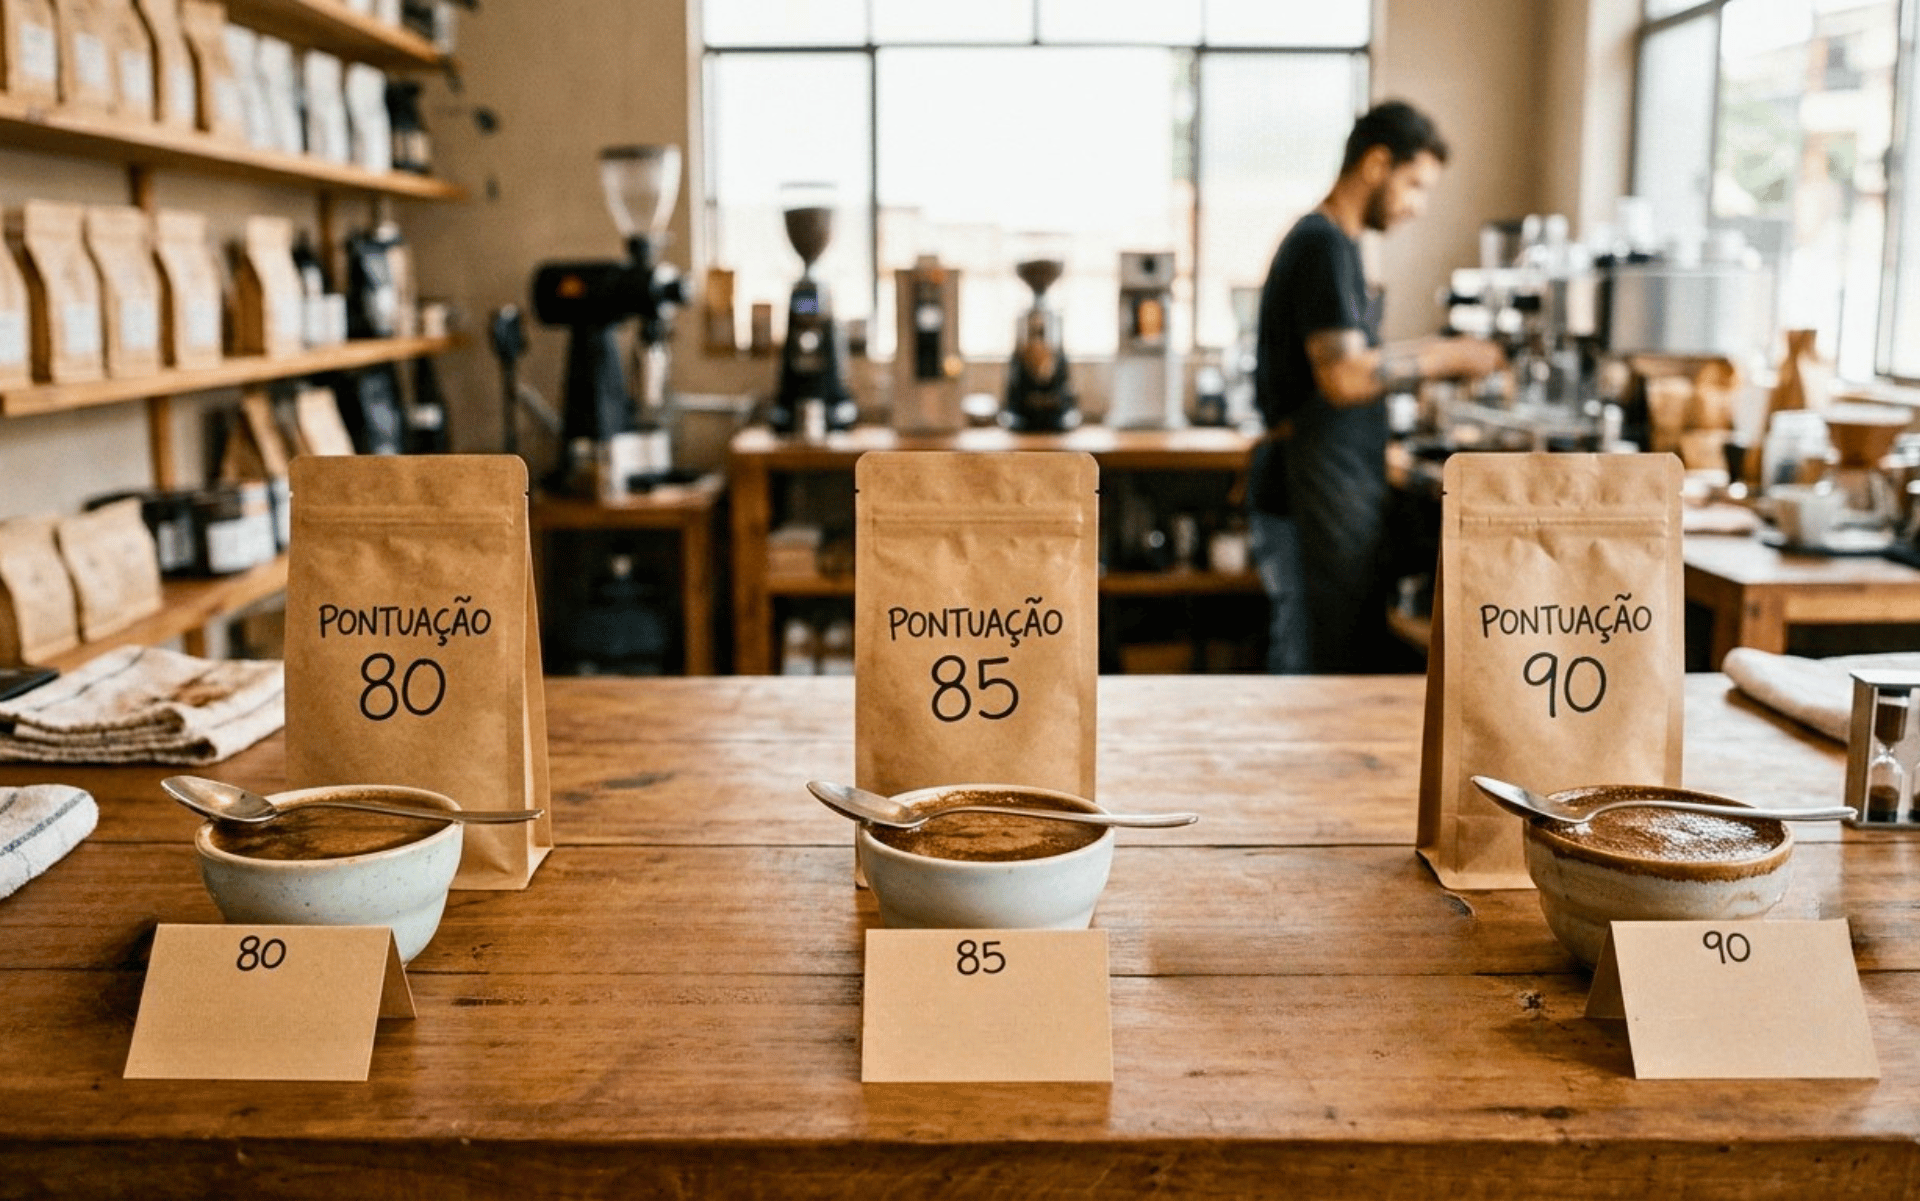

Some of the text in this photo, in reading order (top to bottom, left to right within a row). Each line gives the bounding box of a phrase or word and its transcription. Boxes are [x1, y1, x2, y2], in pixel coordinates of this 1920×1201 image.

[318, 595, 492, 647] PONTUAÇÃO
[887, 596, 1063, 648] PONTUAÇÃO
[1479, 592, 1652, 645] PONTUAÇÃO
[359, 652, 447, 722] 80
[931, 654, 1019, 723] 85
[1523, 652, 1607, 719] 90
[236, 934, 287, 972] 80
[956, 939, 1006, 976] 85
[1702, 930, 1751, 965] 90
